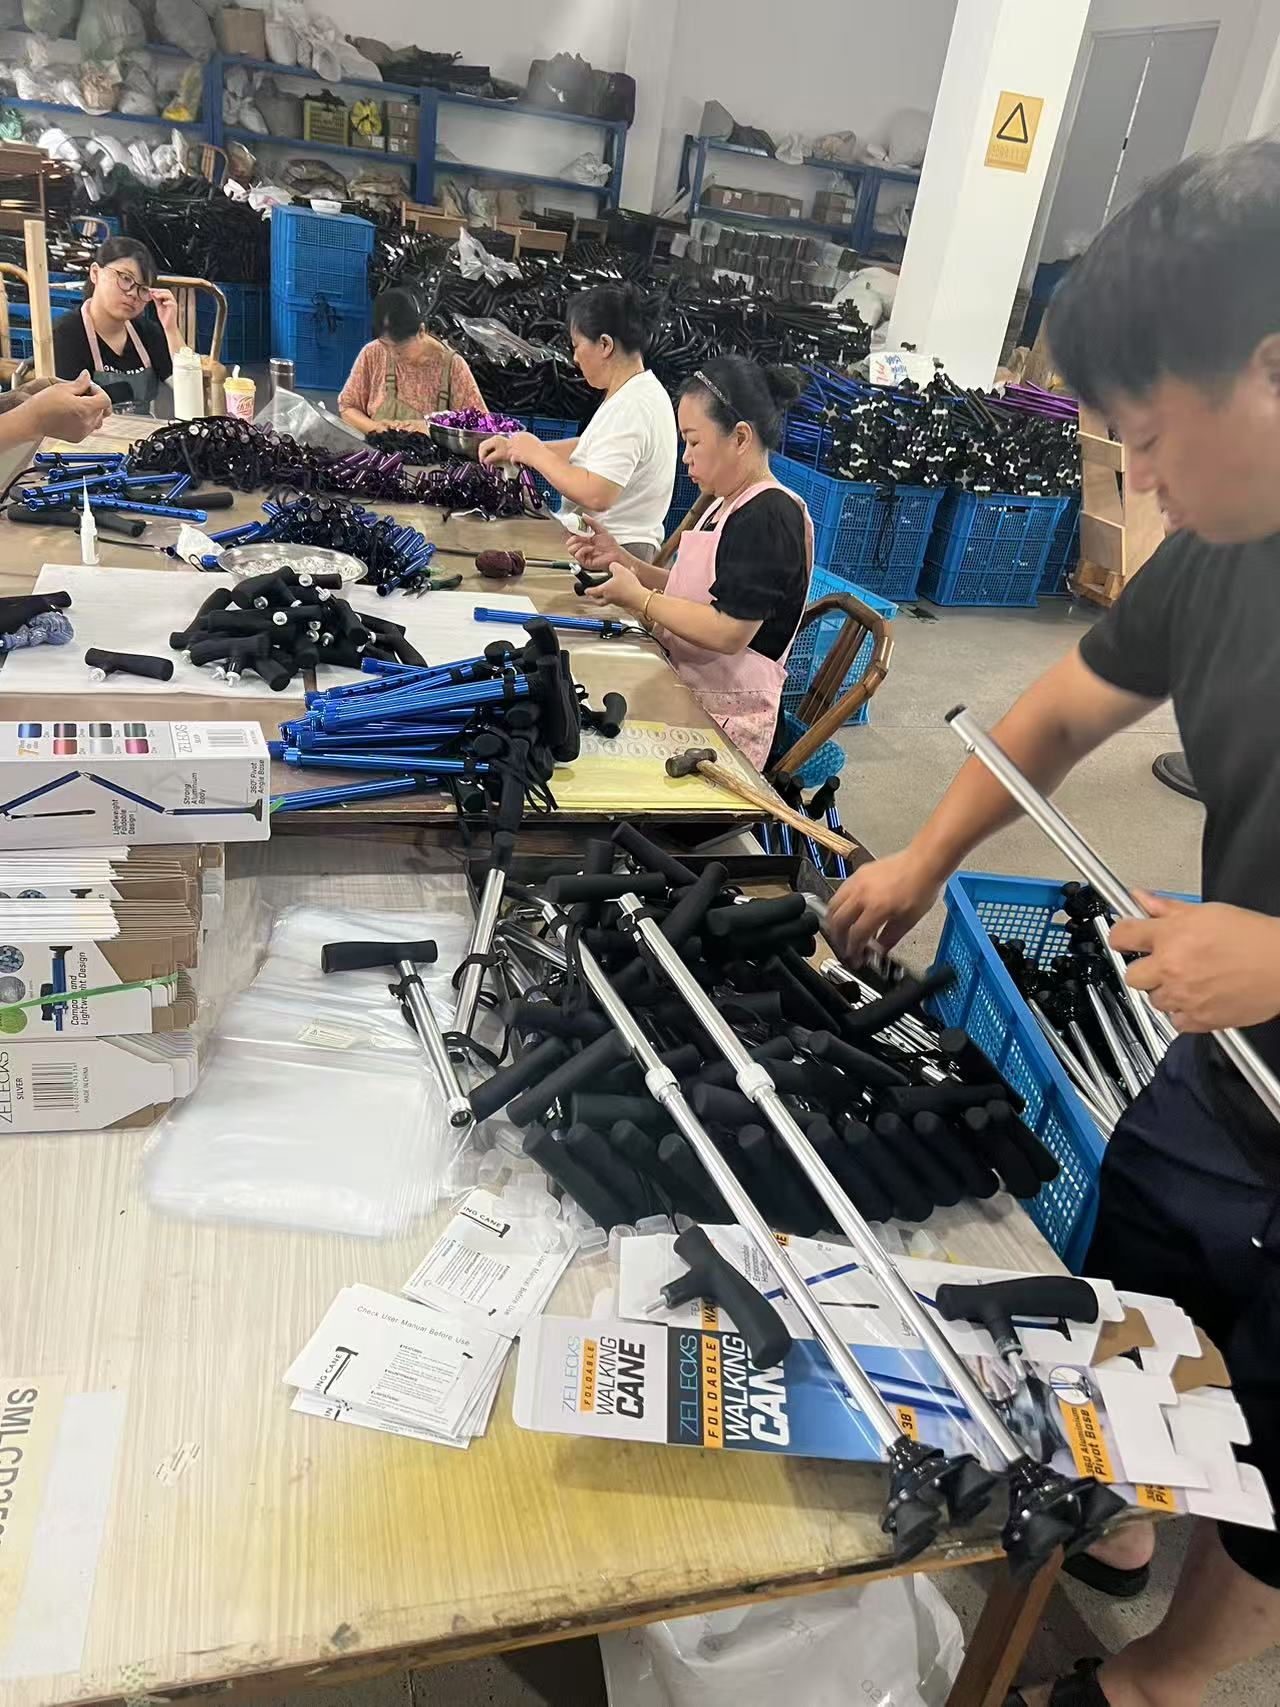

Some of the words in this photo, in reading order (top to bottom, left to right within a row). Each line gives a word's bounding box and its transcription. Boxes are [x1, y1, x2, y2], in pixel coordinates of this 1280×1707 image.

[183, 783, 191, 805] Strong
[78, 951, 89, 979] Design
[71, 993, 80, 1026] Compa
[80, 979, 89, 1026] Lightweht
[16, 1077, 24, 1100] SILVER
[479, 1213, 502, 1228] CANE
[356, 1305, 379, 1317] Check
[381, 1313, 399, 1324] User
[400, 1319, 428, 1334] Manual
[428, 1327, 453, 1341] Before
[455, 1336, 471, 1347] Use
[325, 1353, 343, 1374] CANE
[561, 1335, 581, 1413] ZELECKS
[584, 1345, 596, 1406] FOLDABLE
[596, 1336, 617, 1416] WALKING
[616, 1338, 646, 1420] CANE
[680, 1334, 699, 1438] ZELECKS
[706, 1342, 719, 1439] FOLDABLE
[722, 1334, 751, 1441] WALKING
[749, 1345, 790, 1446] CAN
[1071, 1408, 1089, 1453] Aluminium
[1080, 1409, 1097, 1440] Base
[1083, 1453, 1094, 1475] 360
[1090, 1443, 1107, 1477] Pivot
